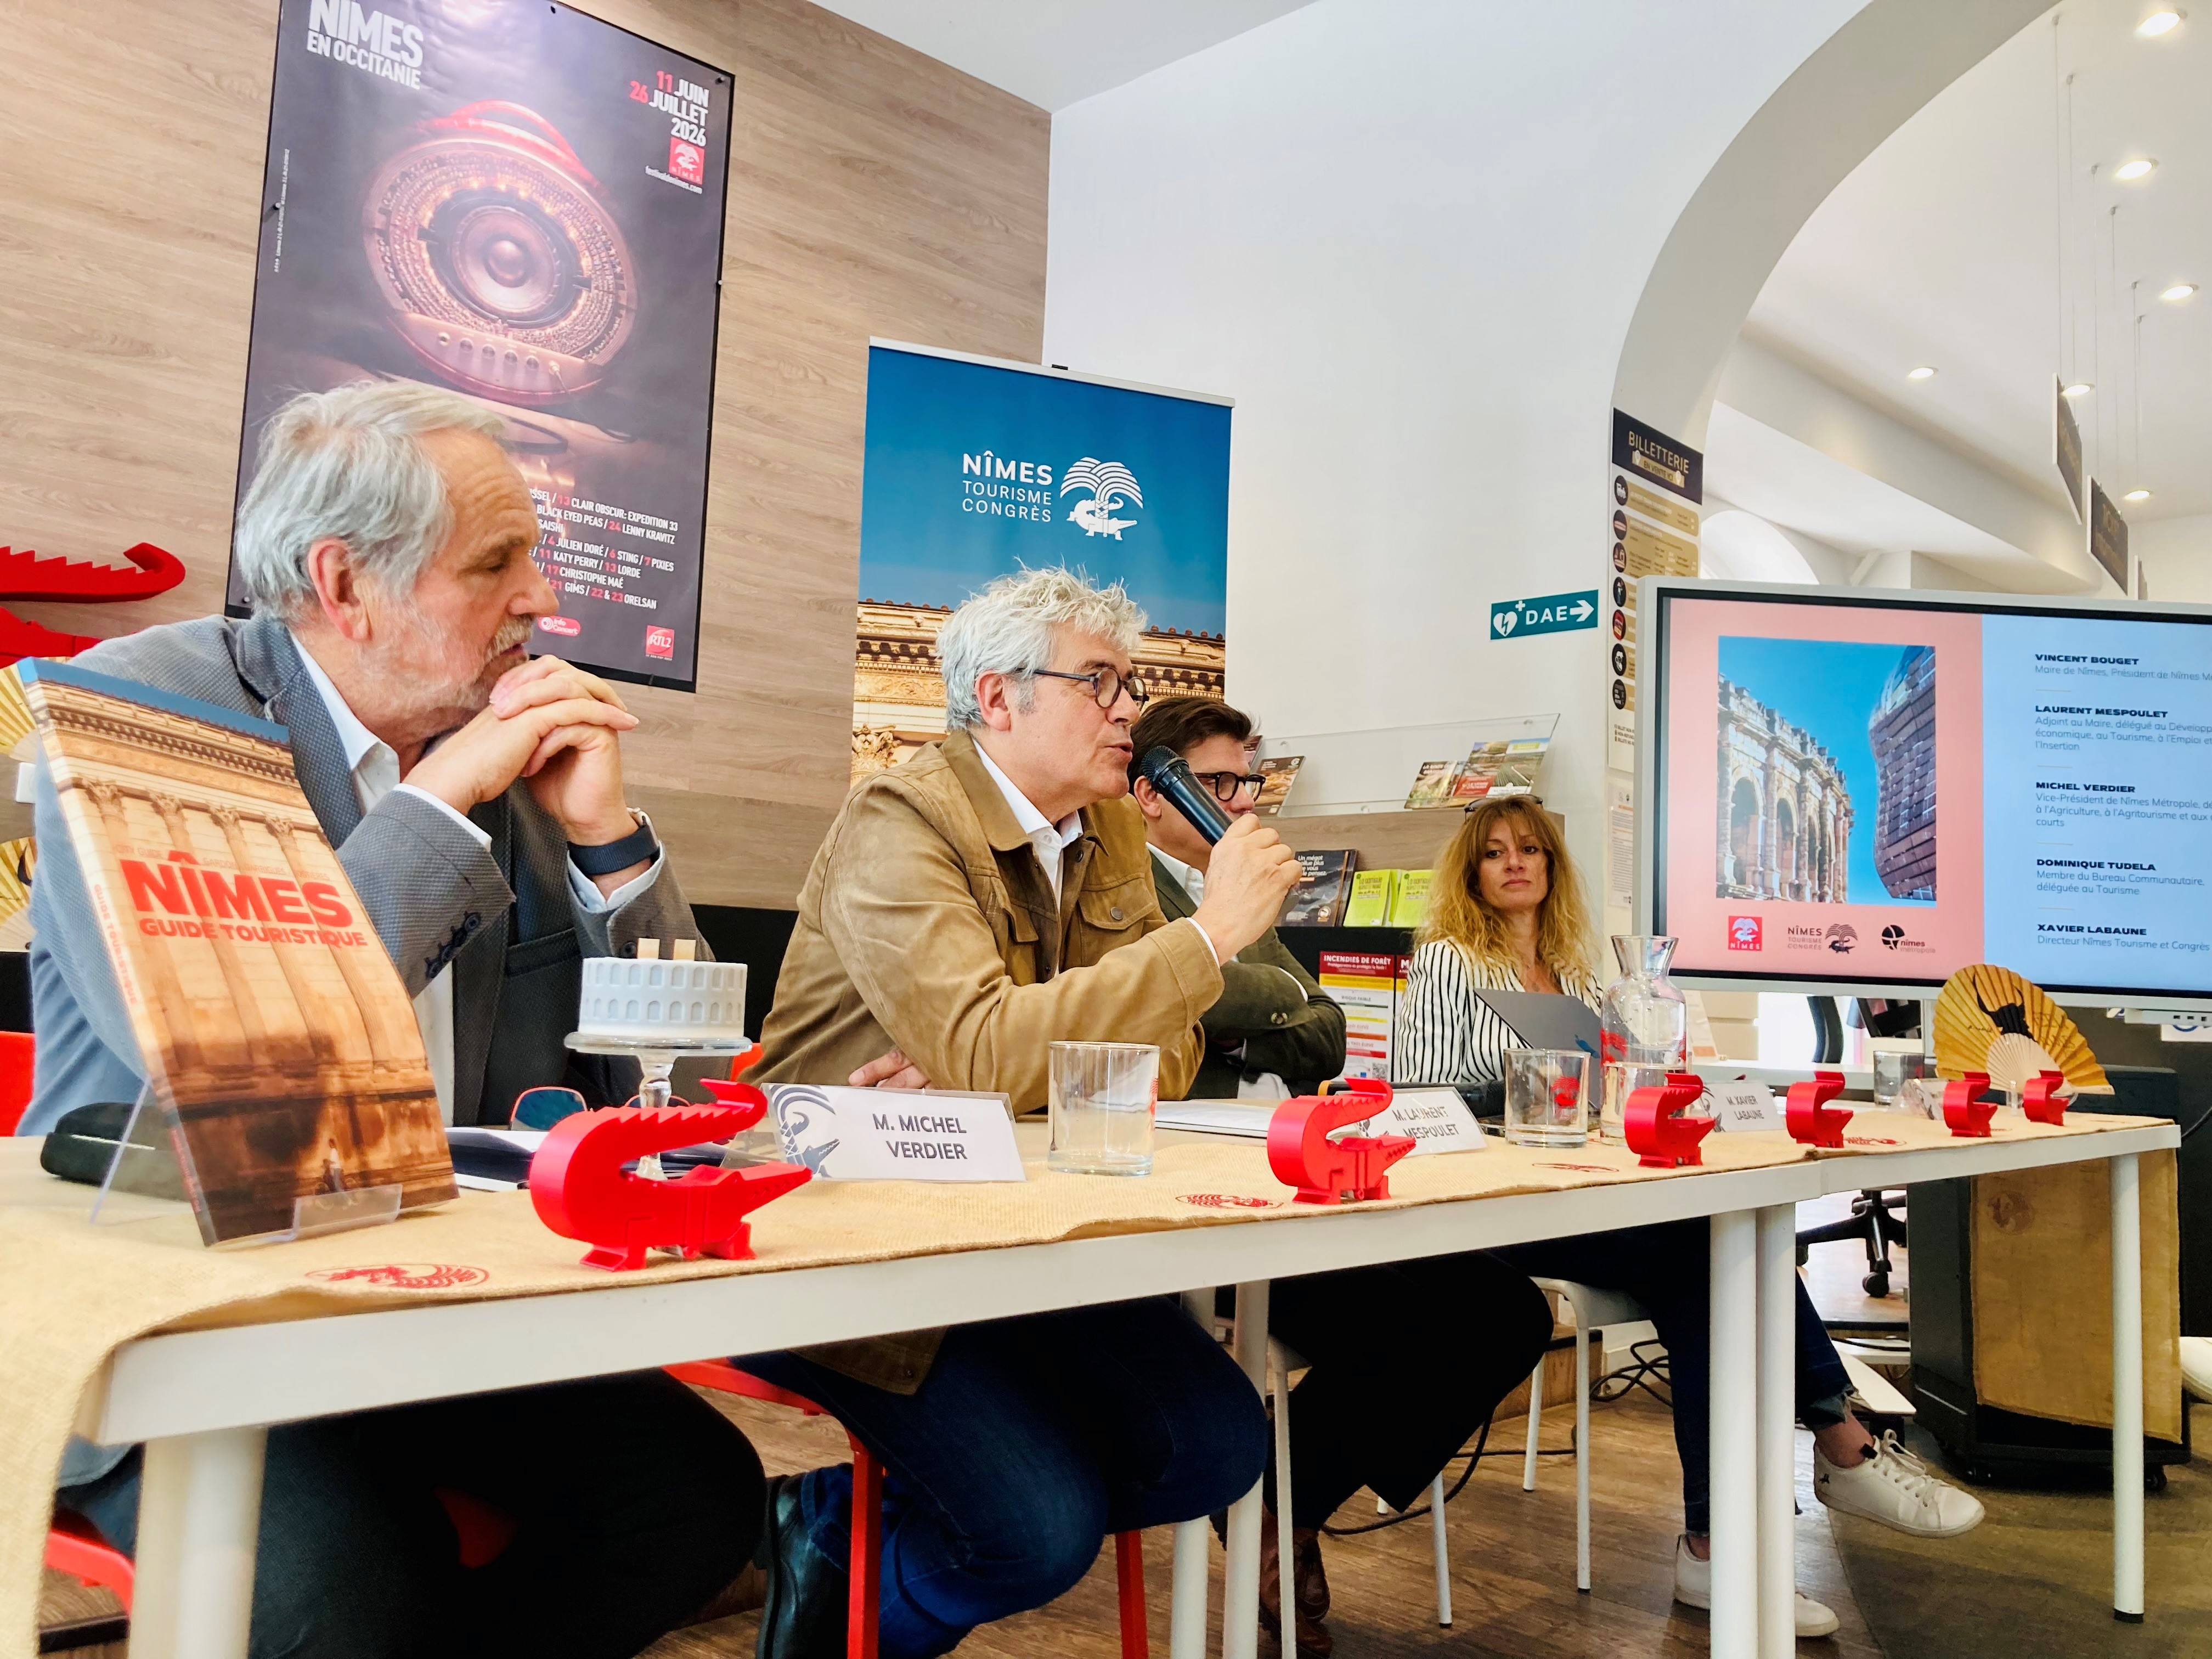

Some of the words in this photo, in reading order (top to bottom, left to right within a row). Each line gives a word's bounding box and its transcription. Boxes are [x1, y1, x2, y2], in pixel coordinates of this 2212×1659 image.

[307, 30, 331, 57] EN
[332, 40, 422, 90] OCCITANIE
[656, 70, 673, 93] 11
[673, 78, 709, 108] JUIN
[629, 80, 650, 104] 26
[648, 89, 709, 127] JUILLET
[670, 117, 707, 147] 2026
[1628, 431, 1689, 474] BILLETTERIE
[962, 449, 1053, 486] NÎMES
[962, 480, 1052, 506] TOURISME
[558, 494, 571, 505] 13
[571, 498, 594, 511] CLAIR
[628, 511, 668, 529] EXPEDITION
[669, 521, 678, 531] 33
[962, 498, 1052, 522] CONGRÈS
[537, 504, 563, 519] BLACK
[563, 510, 583, 523] EYED
[583, 515, 603, 528] PEAS
[608, 520, 622, 532] 24
[622, 523, 645, 538] LENNY
[646, 529, 675, 544] KRAVITZ
[548, 535, 555, 546] 4
[556, 537, 583, 552] JULIEN
[584, 543, 604, 556] DORÉ
[609, 550, 616, 558] 6
[617, 550, 639, 565] STING
[644, 557, 651, 566] 7
[651, 558, 674, 572] PIXIES
[539, 548, 551, 560] 11
[553, 550, 574, 564] KATY
[574, 555, 599, 569] PERRY
[605, 562, 617, 574] 13
[618, 565, 641, 579] LORDE
[546, 563, 560, 575] 17
[560, 566, 607, 585] CHRISTOPHE
[607, 577, 624, 589] MAÉ
[550, 579, 562, 590] 21
[565, 582, 585, 595] GIMS
[590, 588, 604, 599] 22
[604, 590, 611, 601] &
[611, 591, 624, 602] 23
[624, 595, 657, 610] ORELSAN
[1525, 605, 1567, 625] DAE
[649, 634, 672, 648] RTL2
[2035, 653, 2088, 663] VINCENT
[2091, 656, 2140, 665] BOUGET
[2035, 665, 2061, 674] Maire
[2111, 668, 2155, 679] Président
[2157, 671, 2169, 679] de
[2171, 670, 2200, 681] Nîmes
[2035, 705, 2092, 715] LAURENT
[2095, 708, 2169, 718] MESPOULET
[2035, 716, 2069, 727] Adjoint
[2085, 719, 2113, 729] Maire,
[2115, 720, 2152, 732] délégué
[2154, 723, 2166, 731] au
[2035, 728, 2094, 740] économique,
[2110, 731, 2155, 742] Tourisme,
[2158, 733, 2164, 743] à
[2166, 734, 2202, 746] l'Emploi
[2035, 740, 2080, 751] l'Insertion
[2036, 782, 2080, 791] MICHEL
[2083, 784, 2136, 793] VERDIER
[2035, 793, 2103, 804] Vice-Président
[2106, 796, 2118, 804] de
[2120, 796, 2149, 806] Nîmes
[2152, 797, 2200, 809] Métropole,
[2036, 805, 2042, 814] à
[2044, 805, 2102, 817] l'Agriculture,
[2104, 808, 2111, 816] à
[2113, 808, 2177, 820] l'Agritourisme
[2179, 811, 2189, 820] et
[2036, 817, 2065, 827] courts
[2036, 859, 2104, 870] DOMINIQUE
[2108, 862, 2157, 871] TUDELA
[2036, 870, 2075, 880] Membre
[2077, 871, 2090, 881] du
[2092, 872, 2126, 882] Bureau
[2128, 874, 2205, 886] Communautaire,
[120, 850, 353, 928] NÎMES
[2036, 882, 2079, 894] déléguée
[2096, 884, 2140, 895] Tourisme
[94, 884, 111, 923] GUIDE
[139, 918, 218, 939] GUIDE
[220, 924, 369, 948] TOURISTIQUE
[1788, 925, 1822, 936] NÎMES
[2037, 924, 2085, 933] XAVIER
[2087, 926, 2147, 935] LABAUNE
[1730, 940, 1760, 950] NÎMES
[1900, 939, 1926, 947] nîmes
[2038, 935, 2080, 945] Directeur
[2083, 936, 2112, 947] Nîmes
[2114, 938, 2158, 949] Tourisme
[2160, 941, 2169, 950] et
[2171, 941, 2210, 952] Congrès
[109, 923, 137, 1005] TOURISTIQUE
[1324, 955, 1360, 963] INCENDIES
[1371, 956, 1391, 965] FORÊT
[1735, 1096, 1758, 1105] XAVIER
[1392, 1109, 1406, 1121] M.
[1404, 1106, 1449, 1121] LAURENT
[1734, 1110, 1765, 1120] LABAUNE
[872, 1113, 895, 1131] M.
[898, 1114, 967, 1134] MICHEL
[1403, 1124, 1459, 1139] MESPOULET
[886, 1140, 968, 1160] VERDIER
